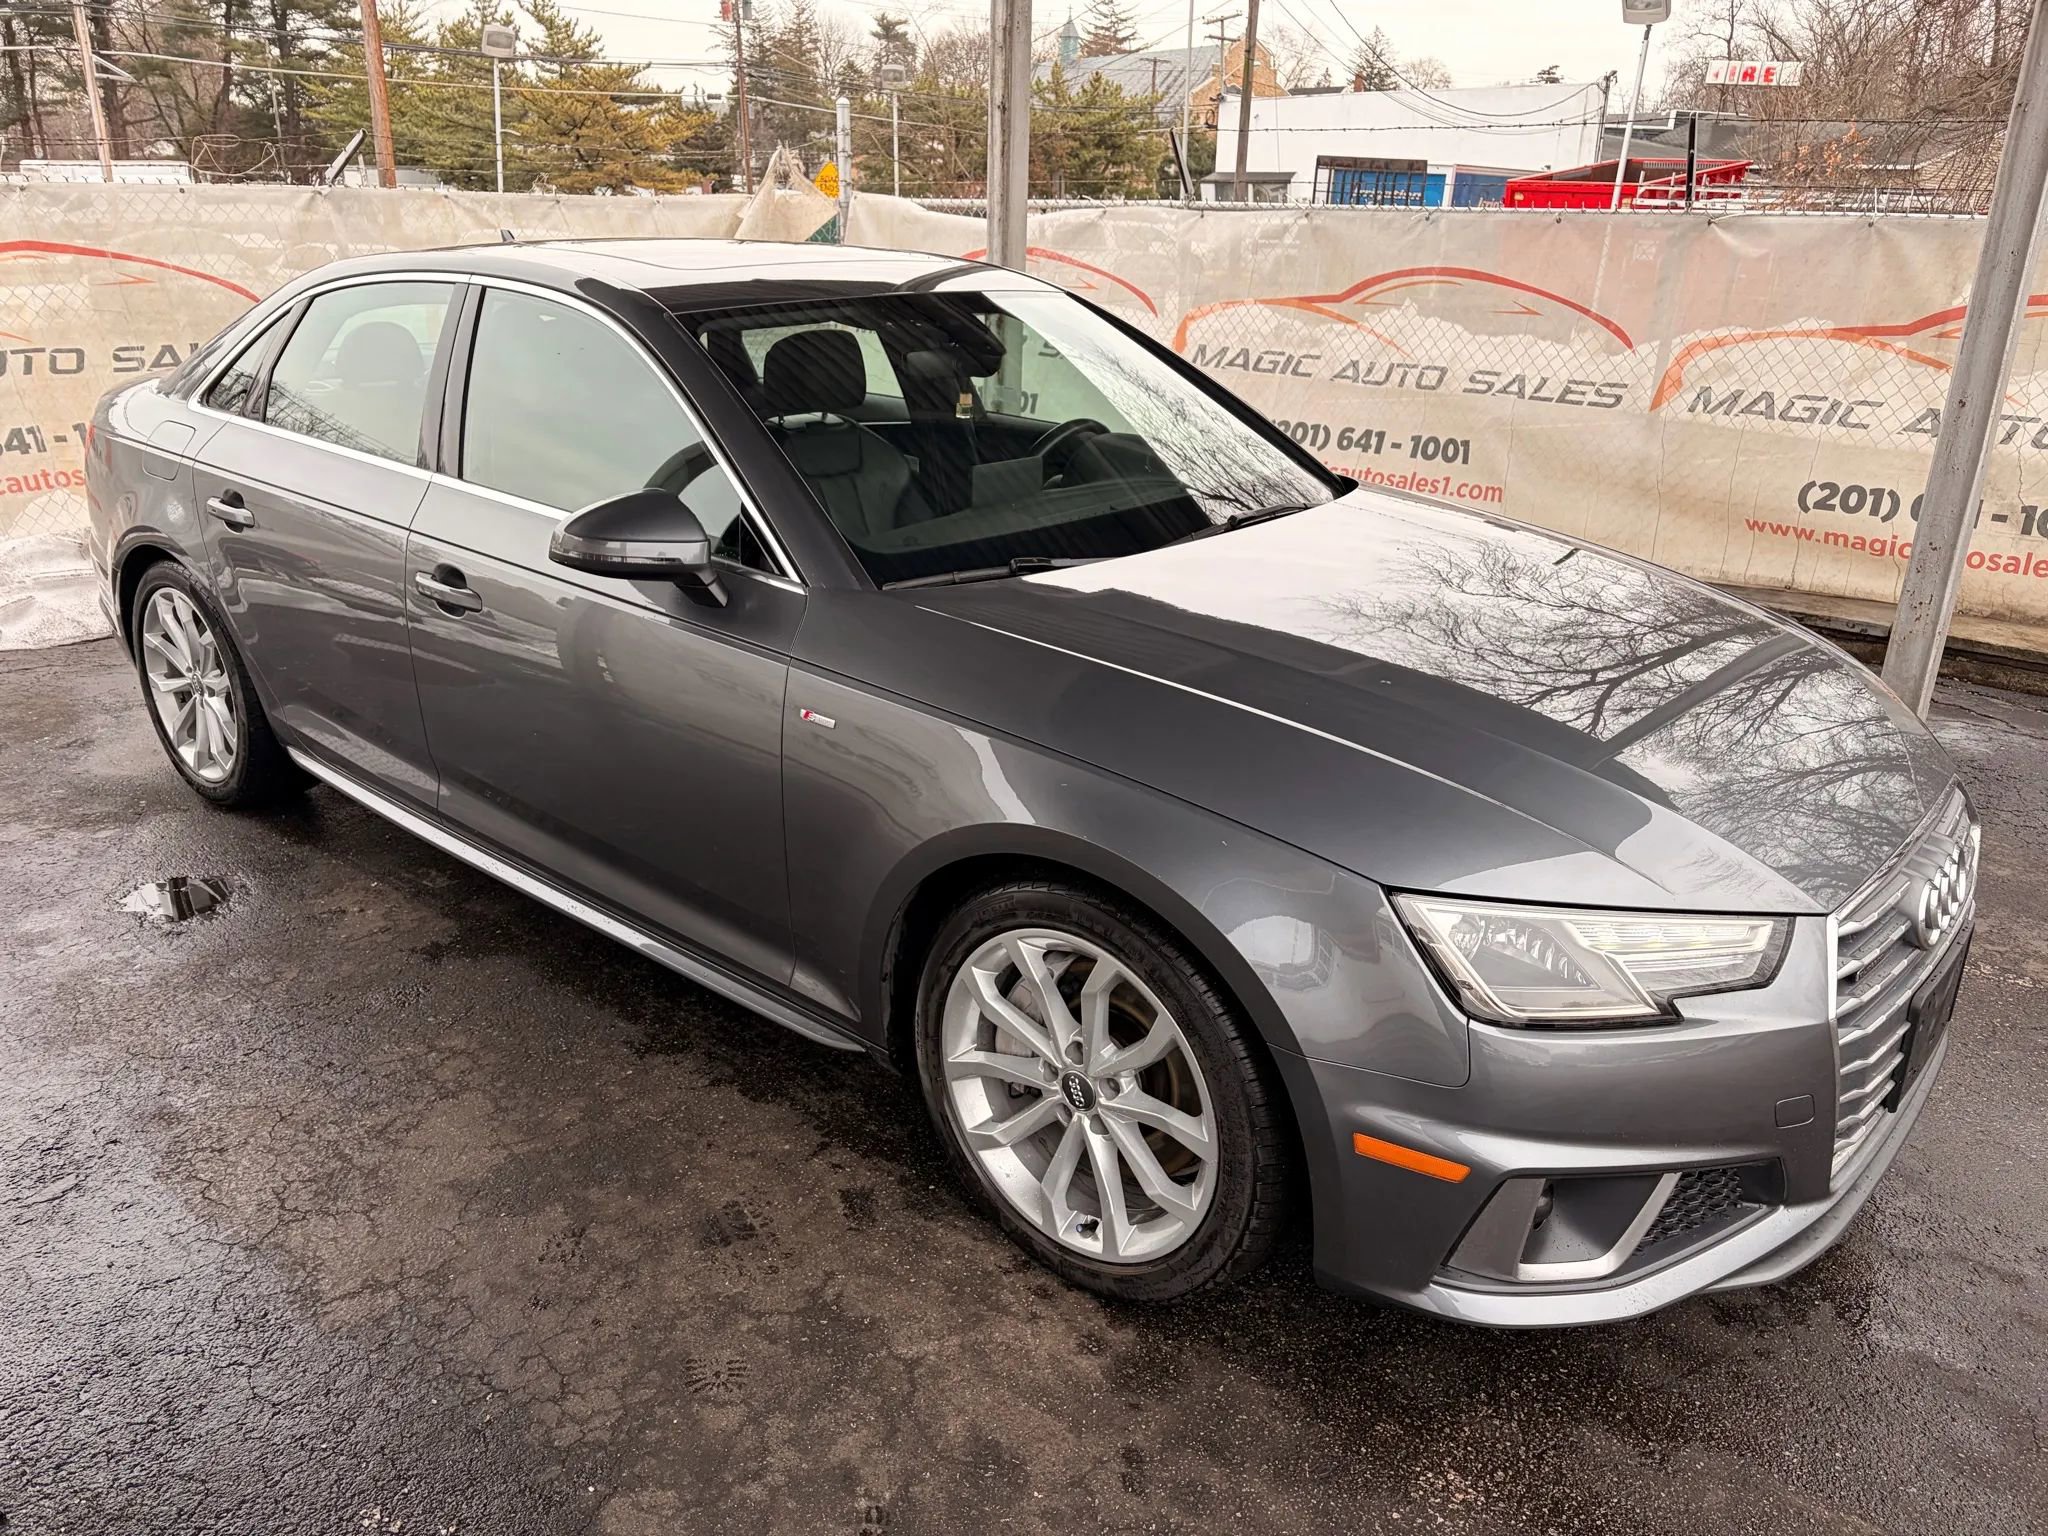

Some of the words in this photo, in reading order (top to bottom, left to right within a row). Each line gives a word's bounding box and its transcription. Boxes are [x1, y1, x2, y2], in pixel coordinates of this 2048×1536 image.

[1713, 65, 1777, 82] IRE
[0, 347, 85, 376] TO
[1191, 343, 1322, 378] MAGIC
[1330, 359, 1449, 391] AUTO
[1462, 369, 1629, 408] SALES
[1687, 386, 1885, 430] MAGIC
[0, 424, 47, 456] 41
[53, 435, 68, 443] -
[1336, 426, 1386, 454] 641
[1390, 441, 1402, 449] -
[1409, 434, 1471, 465] 1001
[1797, 479, 1901, 524] (201)
[1991, 513, 2009, 523] -
